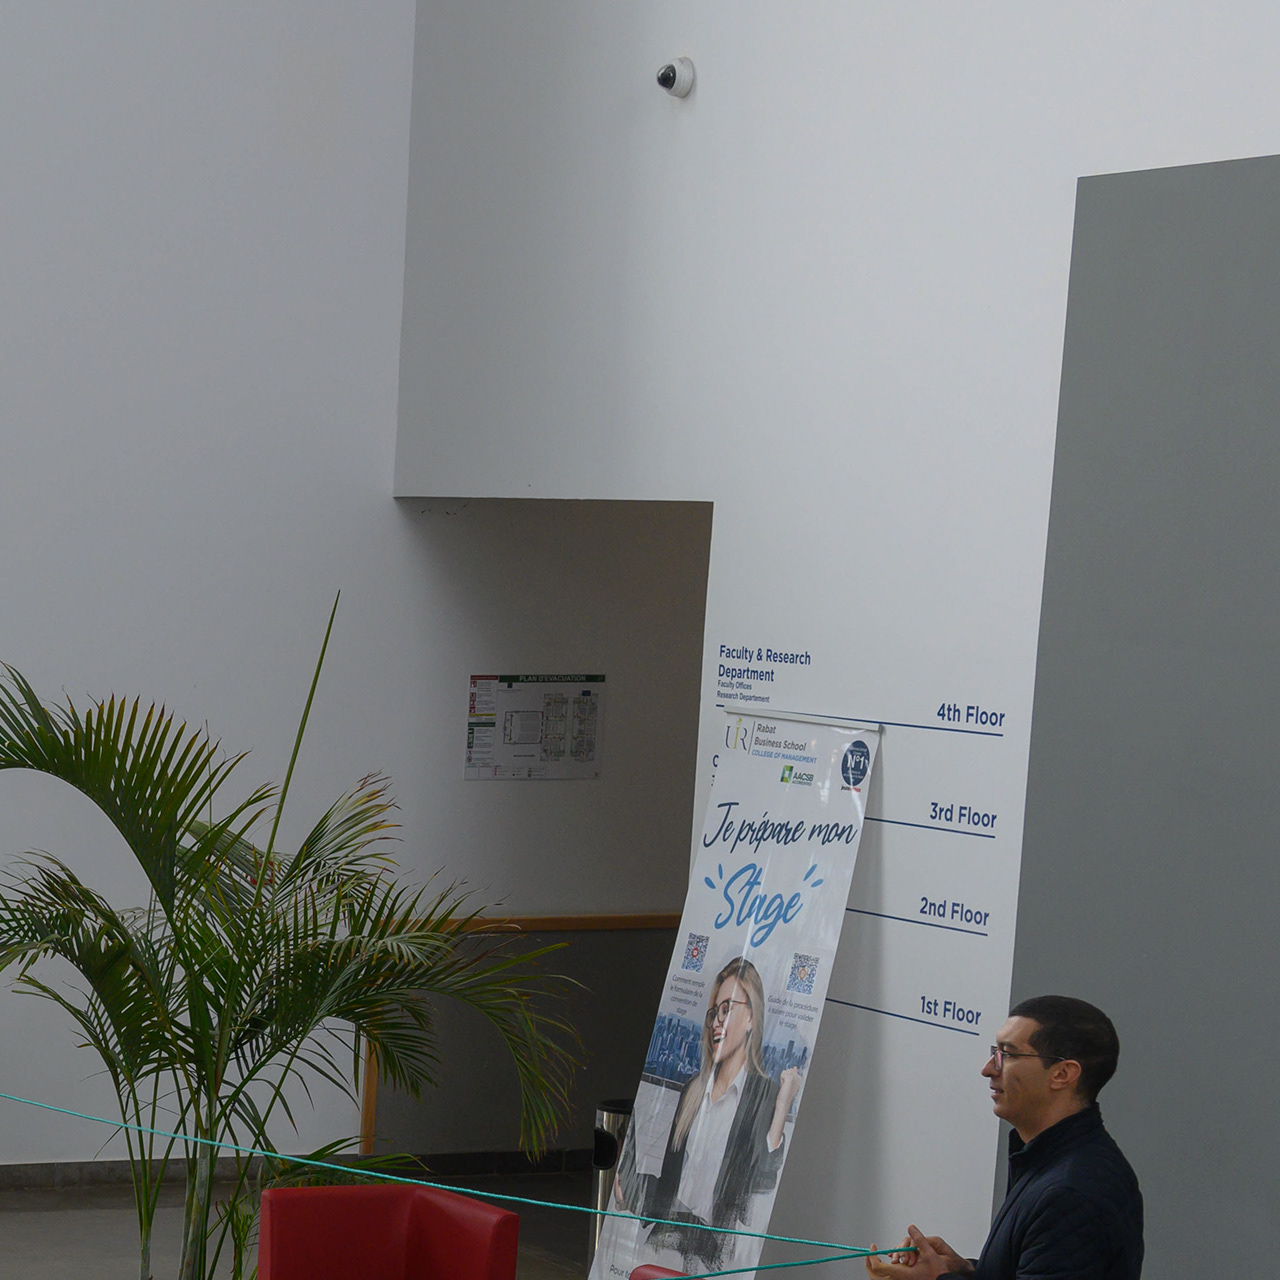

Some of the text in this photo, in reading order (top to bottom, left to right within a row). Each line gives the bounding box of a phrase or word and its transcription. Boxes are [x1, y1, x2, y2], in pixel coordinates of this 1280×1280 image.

[719, 644, 811, 665] Faculty & Research
[718, 664, 775, 682] Department
[717, 680, 752, 690] Faculty Offices
[717, 691, 738, 700] Research
[937, 703, 1005, 727] 4th Floor
[757, 723, 776, 734] Rabat
[754, 736, 807, 751] Business School
[751, 749, 774, 759] COLLEGE
[781, 753, 817, 764] MANAGEMENT
[793, 772, 814, 781] AACSB
[930, 802, 997, 828] 3rd Floor
[703, 802, 858, 854] Je prépare mon
[714, 863, 804, 948] Stage
[919, 897, 989, 926] 2nd Floor
[920, 996, 981, 1025] 1st Floor
